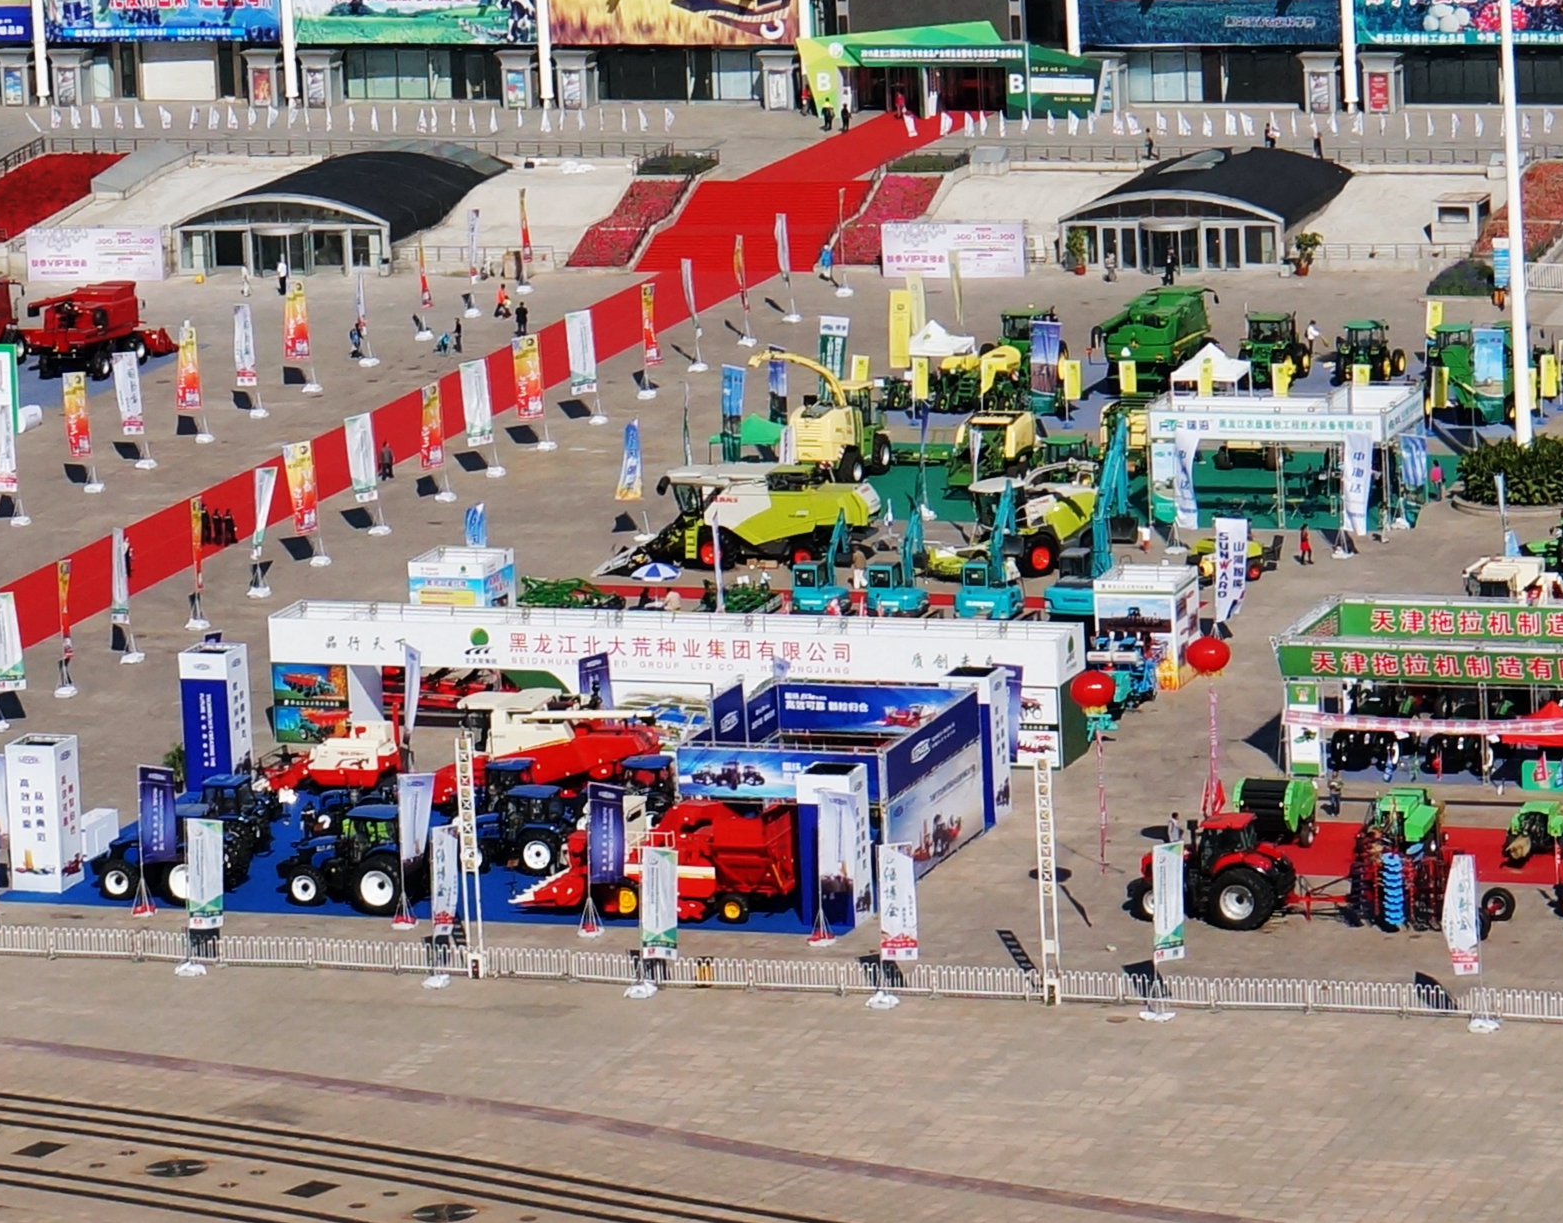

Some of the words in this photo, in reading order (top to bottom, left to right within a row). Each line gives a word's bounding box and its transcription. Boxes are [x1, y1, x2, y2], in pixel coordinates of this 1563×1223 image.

[816, 72, 832, 91] B
[1009, 74, 1025, 94] B
[1218, 531, 1232, 599] SUNWARD
[509, 632, 853, 663] 黑龙江北大荒种业集团有限公司
[512, 656, 578, 668] BEIDAHUAN
[639, 660, 680, 670] GROUP
[690, 661, 714, 671] LTD
